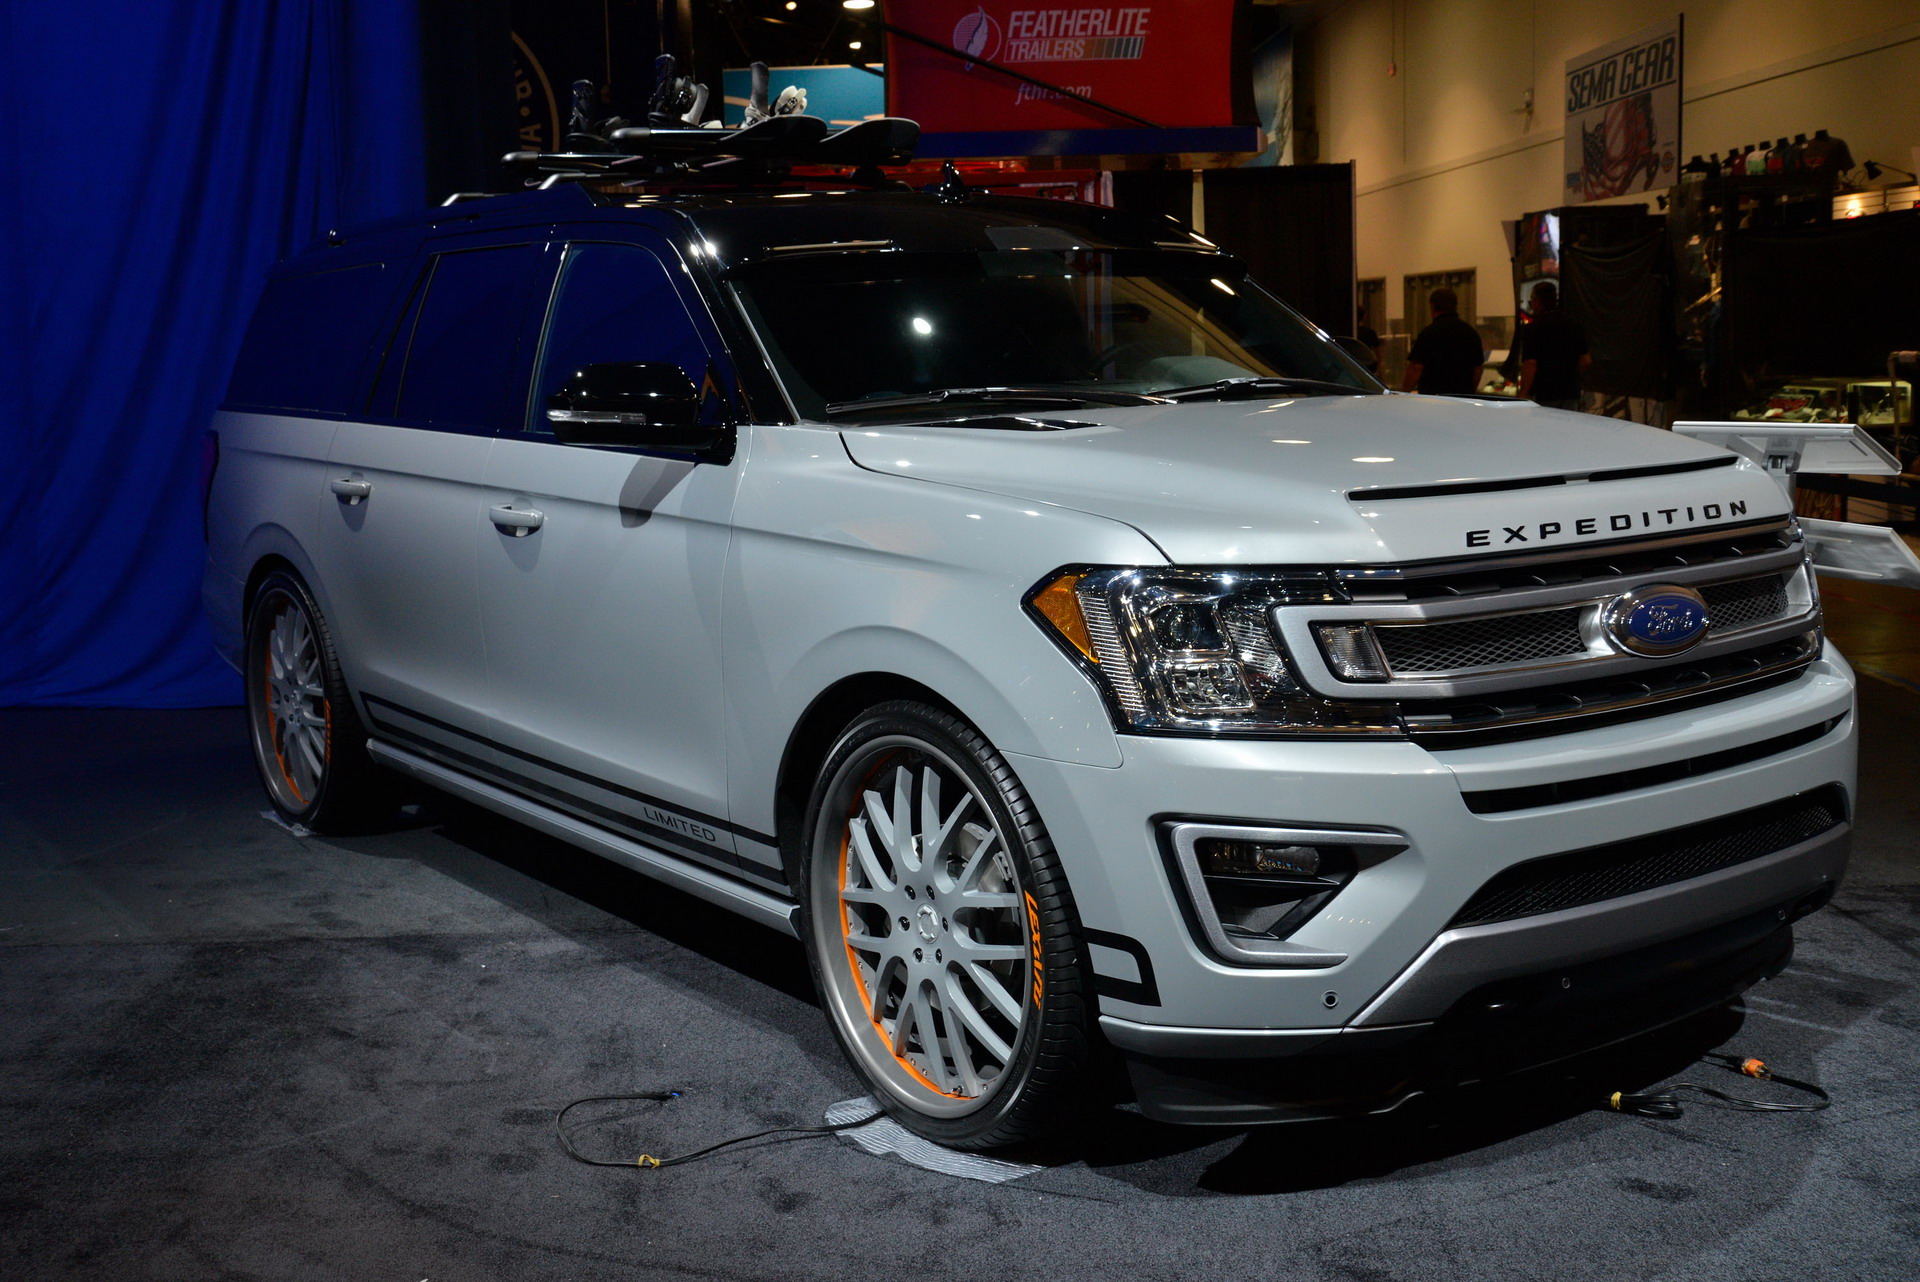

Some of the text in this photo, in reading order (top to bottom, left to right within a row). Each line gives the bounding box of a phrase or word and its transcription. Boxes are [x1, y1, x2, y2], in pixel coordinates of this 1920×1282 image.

[1007, 8, 1151, 38] FEATHERLITE
[1008, 39, 1086, 60] TRAILERS
[1568, 37, 1676, 112] SEMA GEAR
[1466, 500, 1747, 548] EXPEDITION
[1647, 604, 1693, 637] Ford
[643, 807, 716, 842] LIMITED
